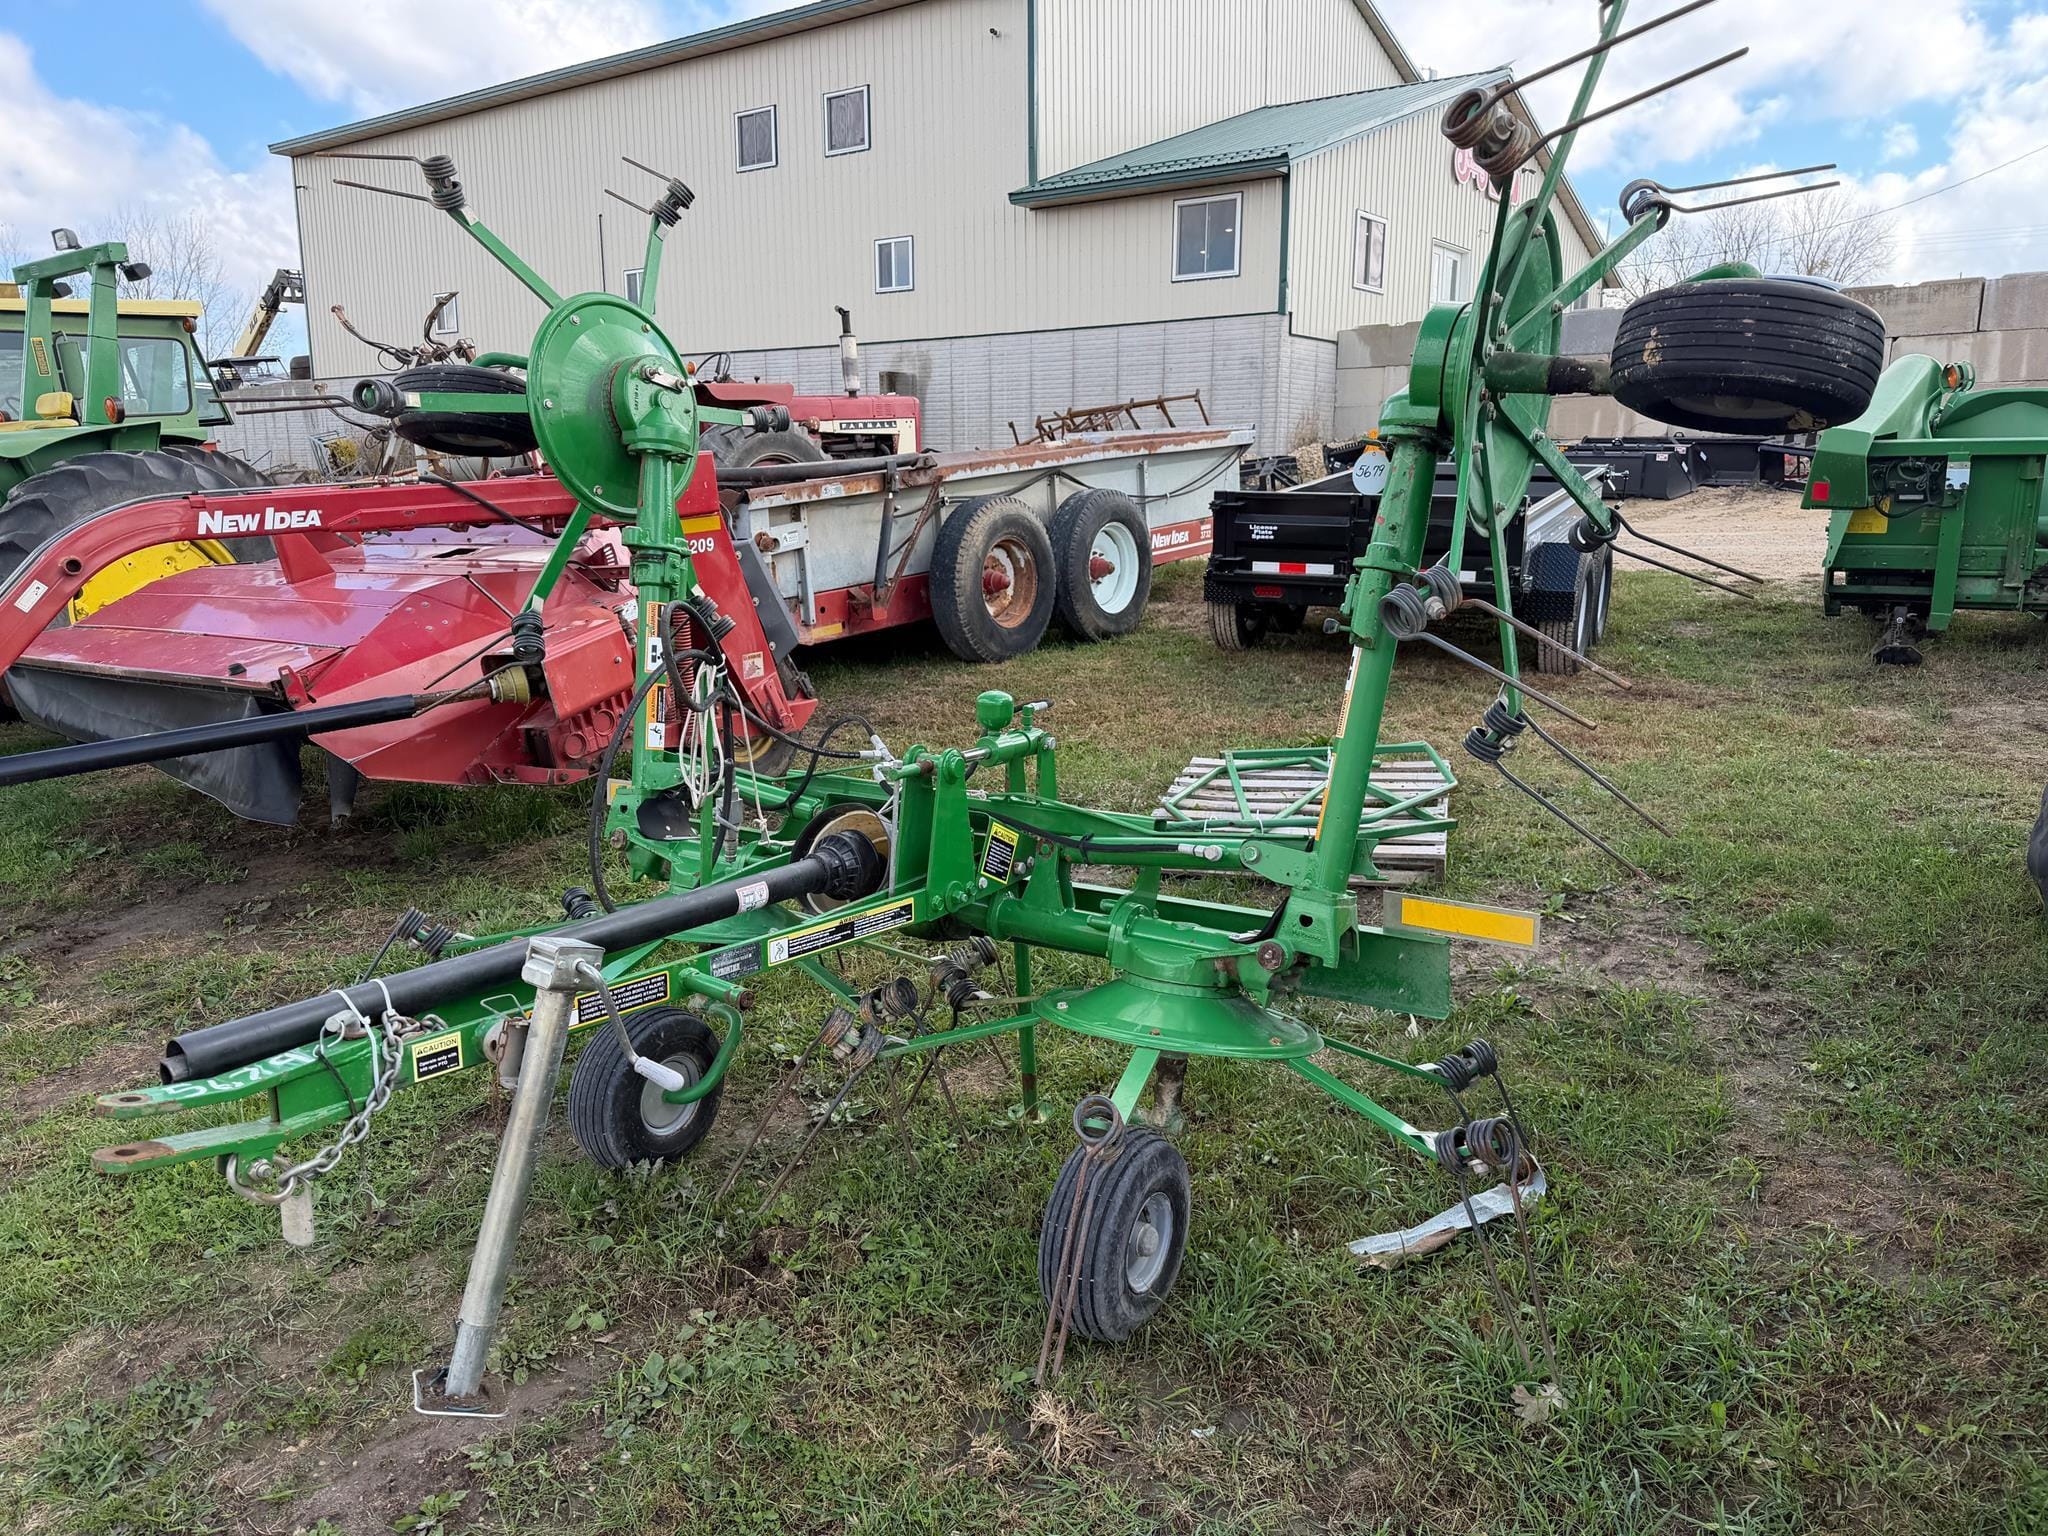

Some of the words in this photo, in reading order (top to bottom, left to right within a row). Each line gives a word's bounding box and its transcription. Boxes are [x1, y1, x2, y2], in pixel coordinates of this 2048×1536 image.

[841, 421, 897, 429] FARMALL
[1355, 464, 1386, 478] 5679
[423, 1038, 457, 1054] CAUTION
